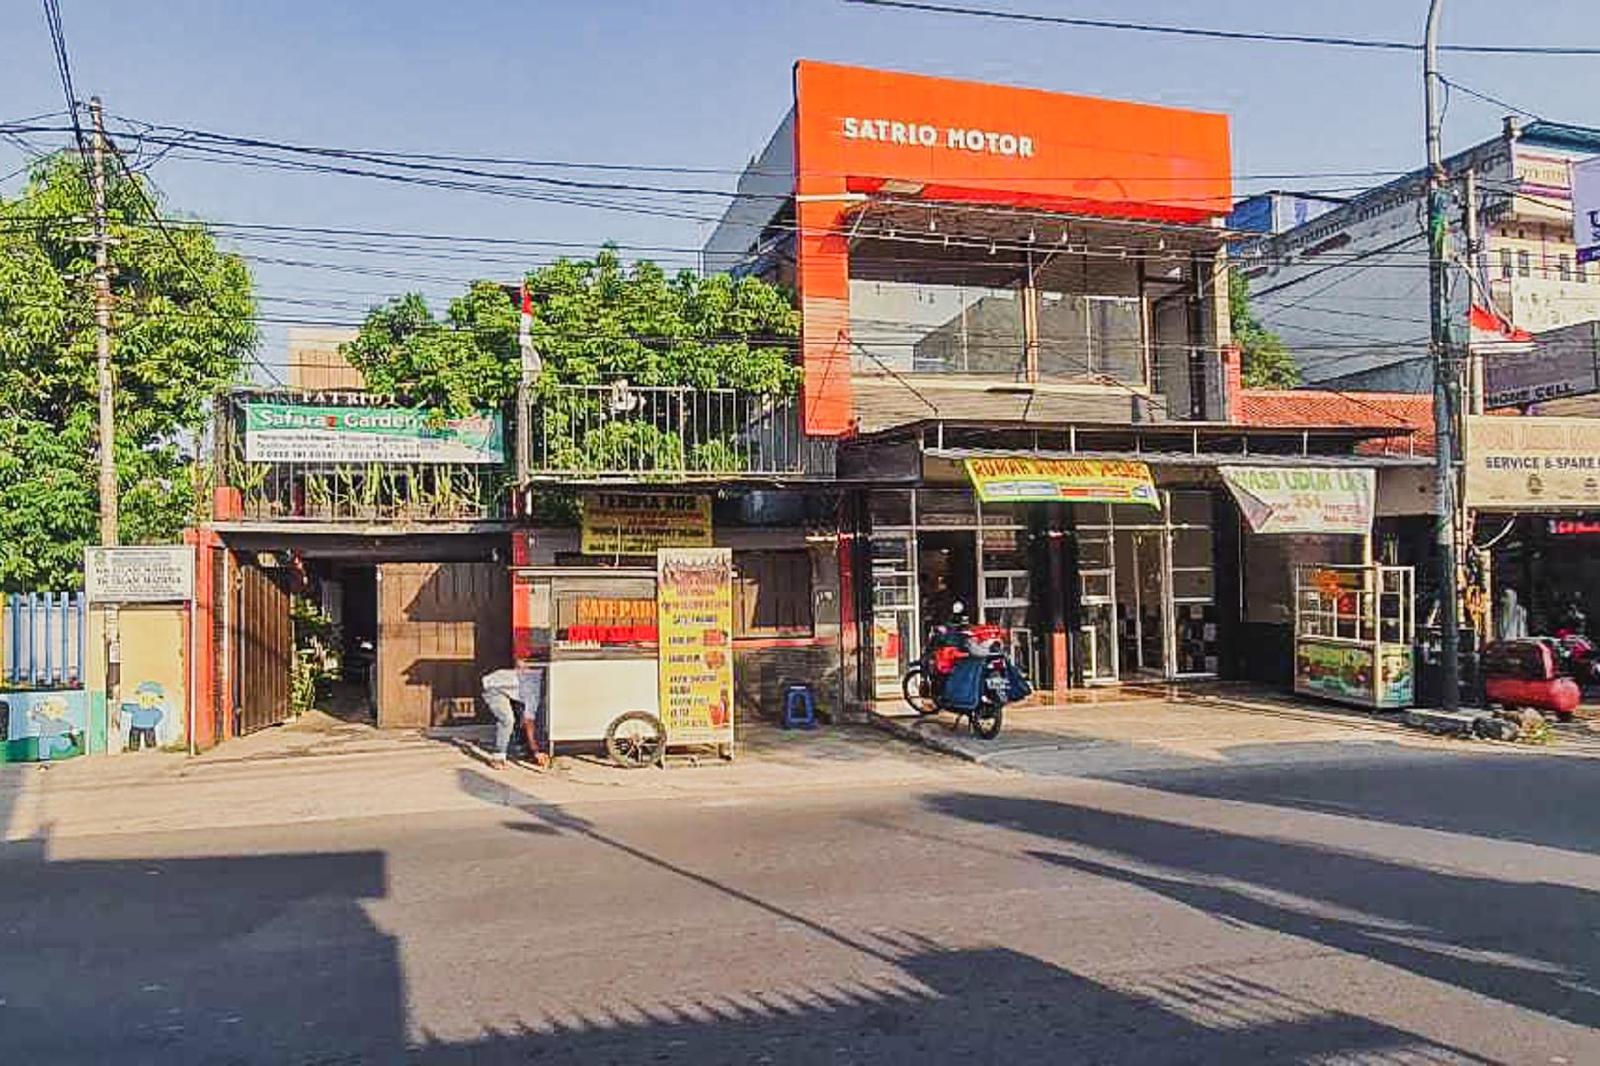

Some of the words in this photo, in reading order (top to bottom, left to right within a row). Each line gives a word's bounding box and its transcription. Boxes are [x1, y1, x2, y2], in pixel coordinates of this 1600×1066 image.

[843, 116, 938, 147] SATRIO
[947, 127, 1034, 158] MOTOR
[344, 410, 417, 431] Garden
[1485, 456, 1541, 469] SERVICE
[1556, 456, 1594, 469] SPARE
[1284, 470, 1333, 491] UDUK
